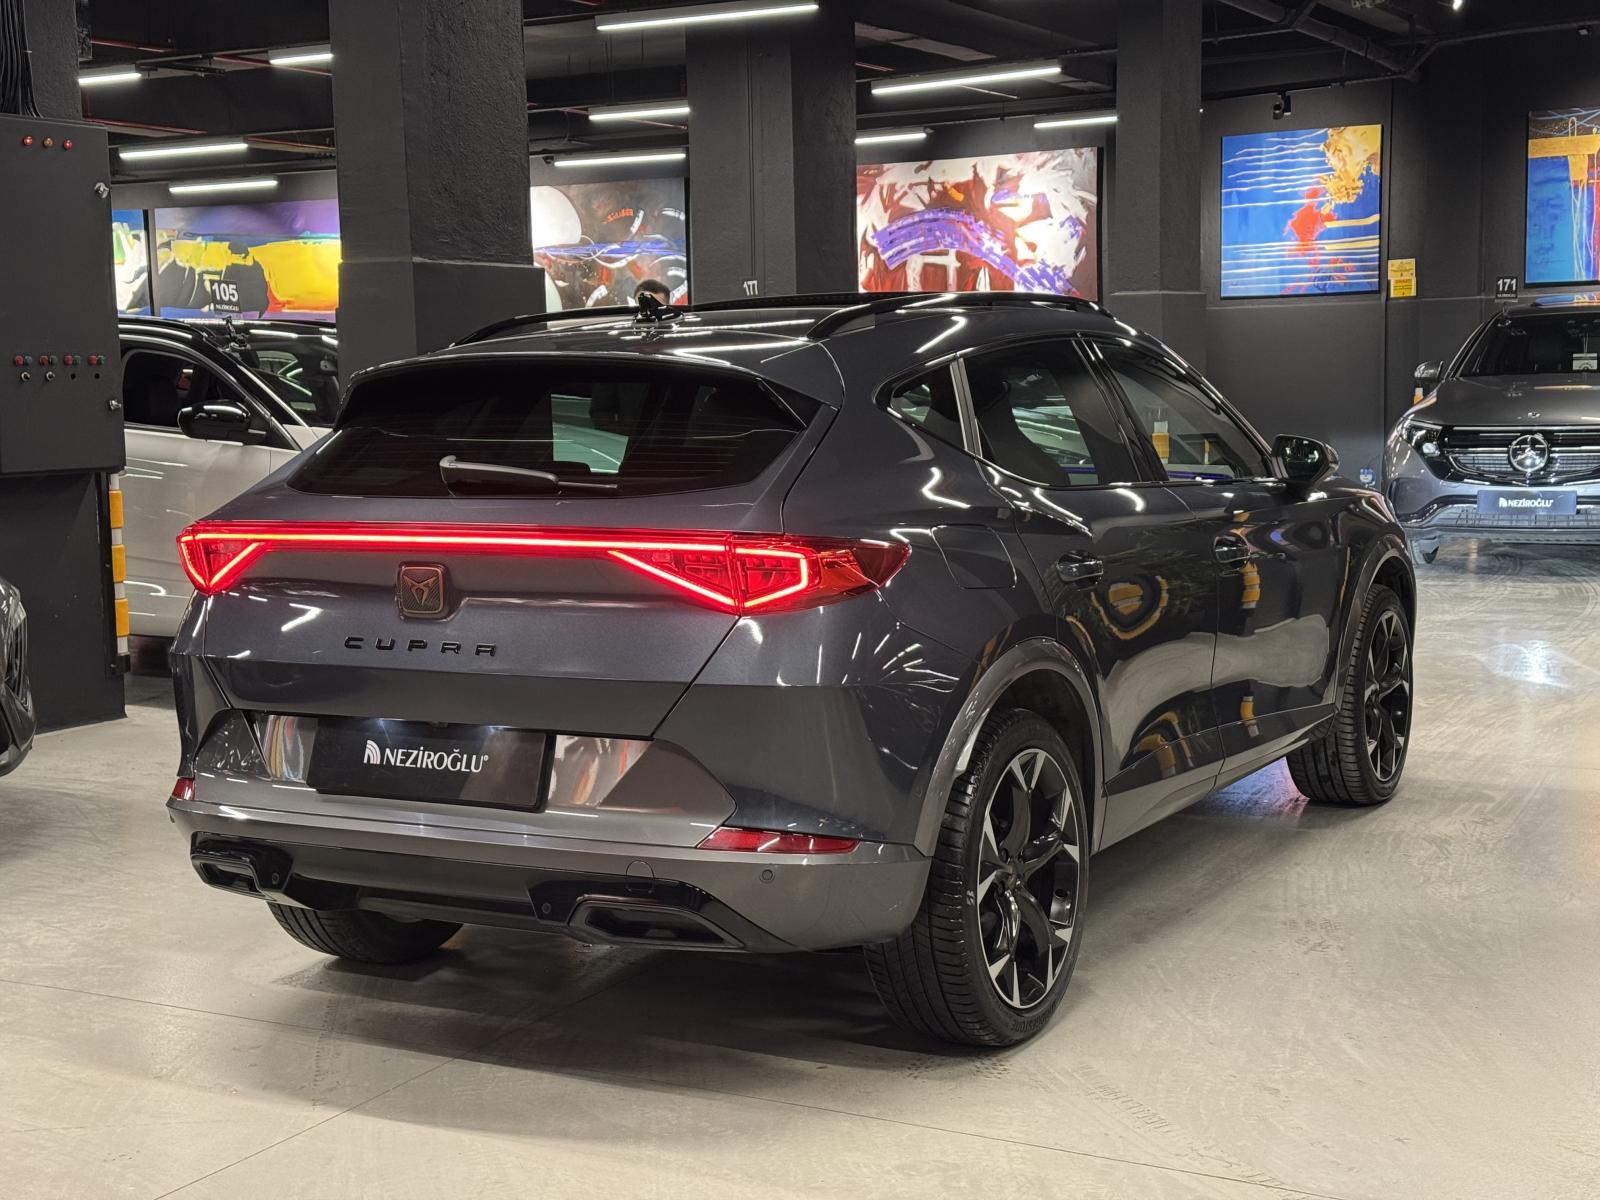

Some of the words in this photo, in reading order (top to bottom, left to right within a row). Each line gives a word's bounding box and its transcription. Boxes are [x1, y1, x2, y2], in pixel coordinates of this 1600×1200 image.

[211, 282, 239, 302] 105
[743, 279, 758, 296] 177
[1497, 278, 1517, 292] 171
[344, 636, 497, 657] CUPRA
